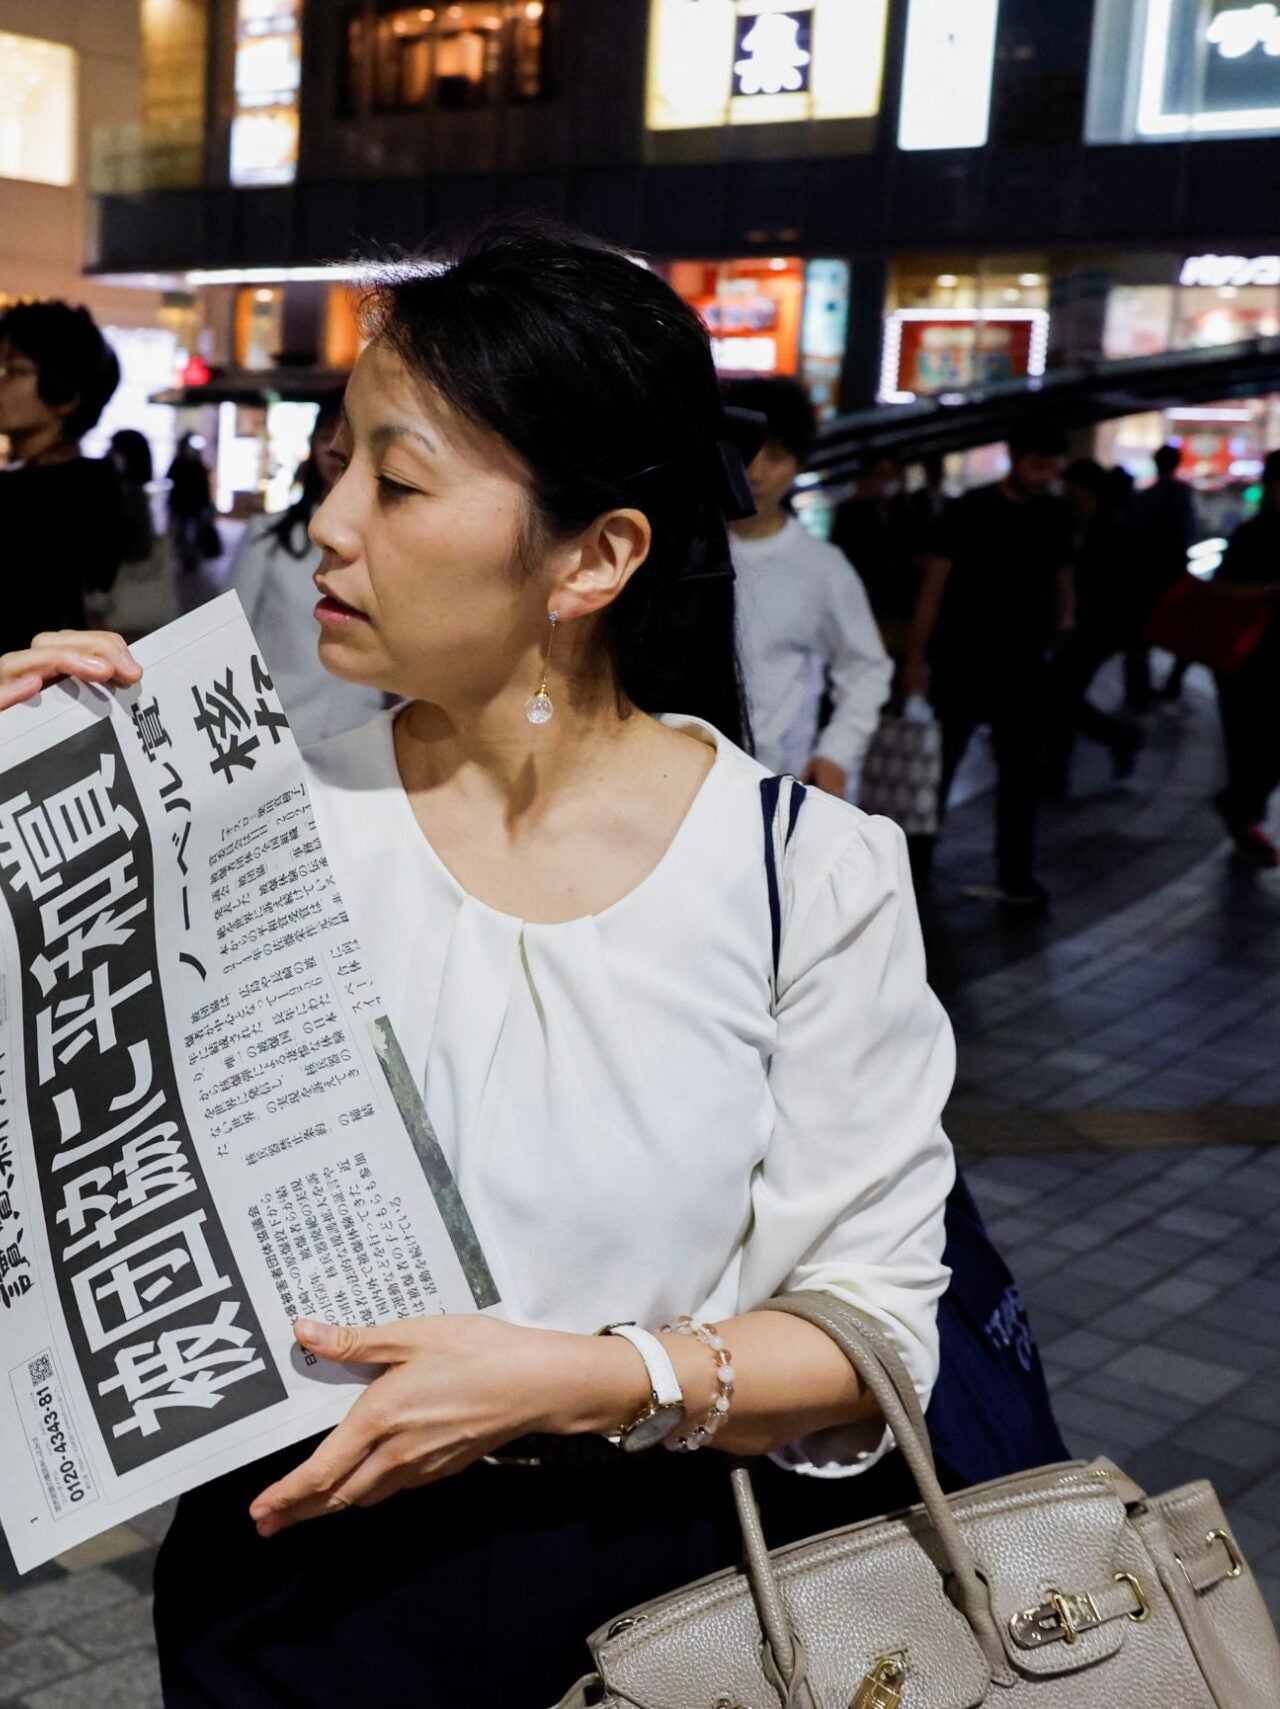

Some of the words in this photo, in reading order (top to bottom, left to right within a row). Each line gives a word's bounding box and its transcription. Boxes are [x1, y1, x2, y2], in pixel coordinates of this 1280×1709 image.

[128, 694, 209, 980] ノーベル賞
